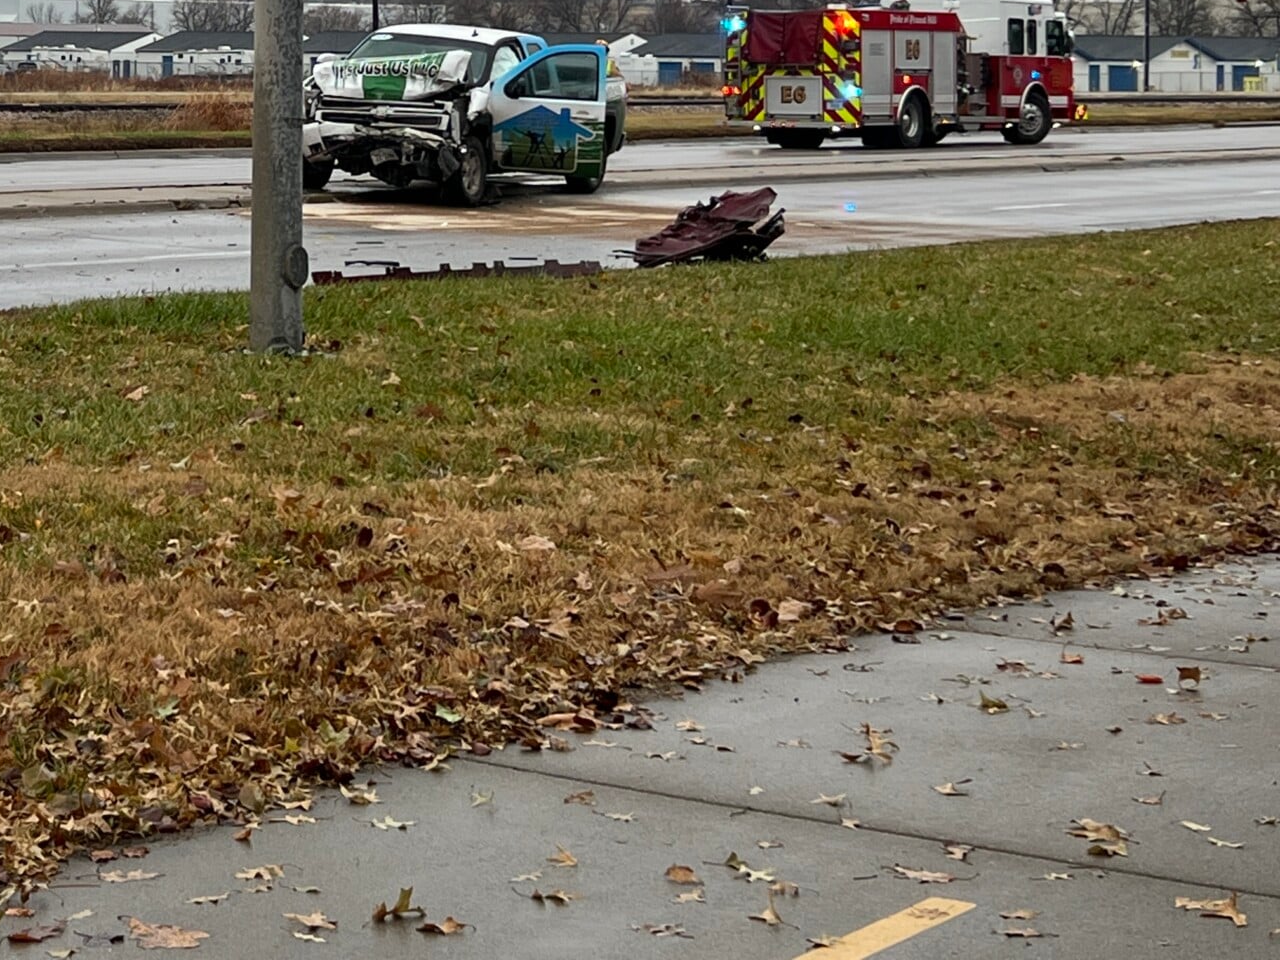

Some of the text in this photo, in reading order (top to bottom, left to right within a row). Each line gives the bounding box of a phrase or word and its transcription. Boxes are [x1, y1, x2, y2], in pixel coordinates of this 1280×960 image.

[905, 39, 921, 60] E6
[357, 61, 387, 75] Just
[391, 61, 409, 75] Us
[780, 85, 807, 104] E6
